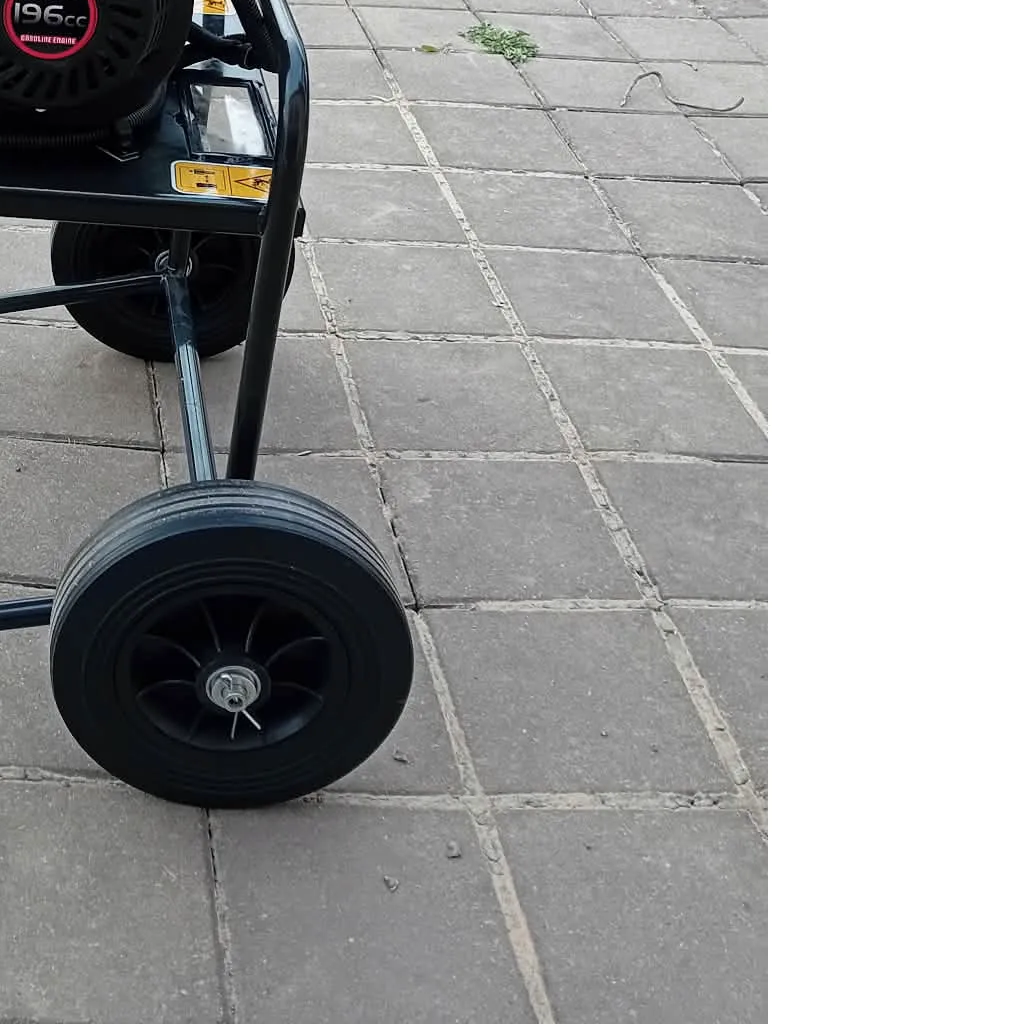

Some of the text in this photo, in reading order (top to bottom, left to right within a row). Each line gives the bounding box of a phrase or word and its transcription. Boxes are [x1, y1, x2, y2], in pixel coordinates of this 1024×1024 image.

[14, 2, 88, 28] 196cc
[20, 34, 77, 45] GASOLINE ENGINE
